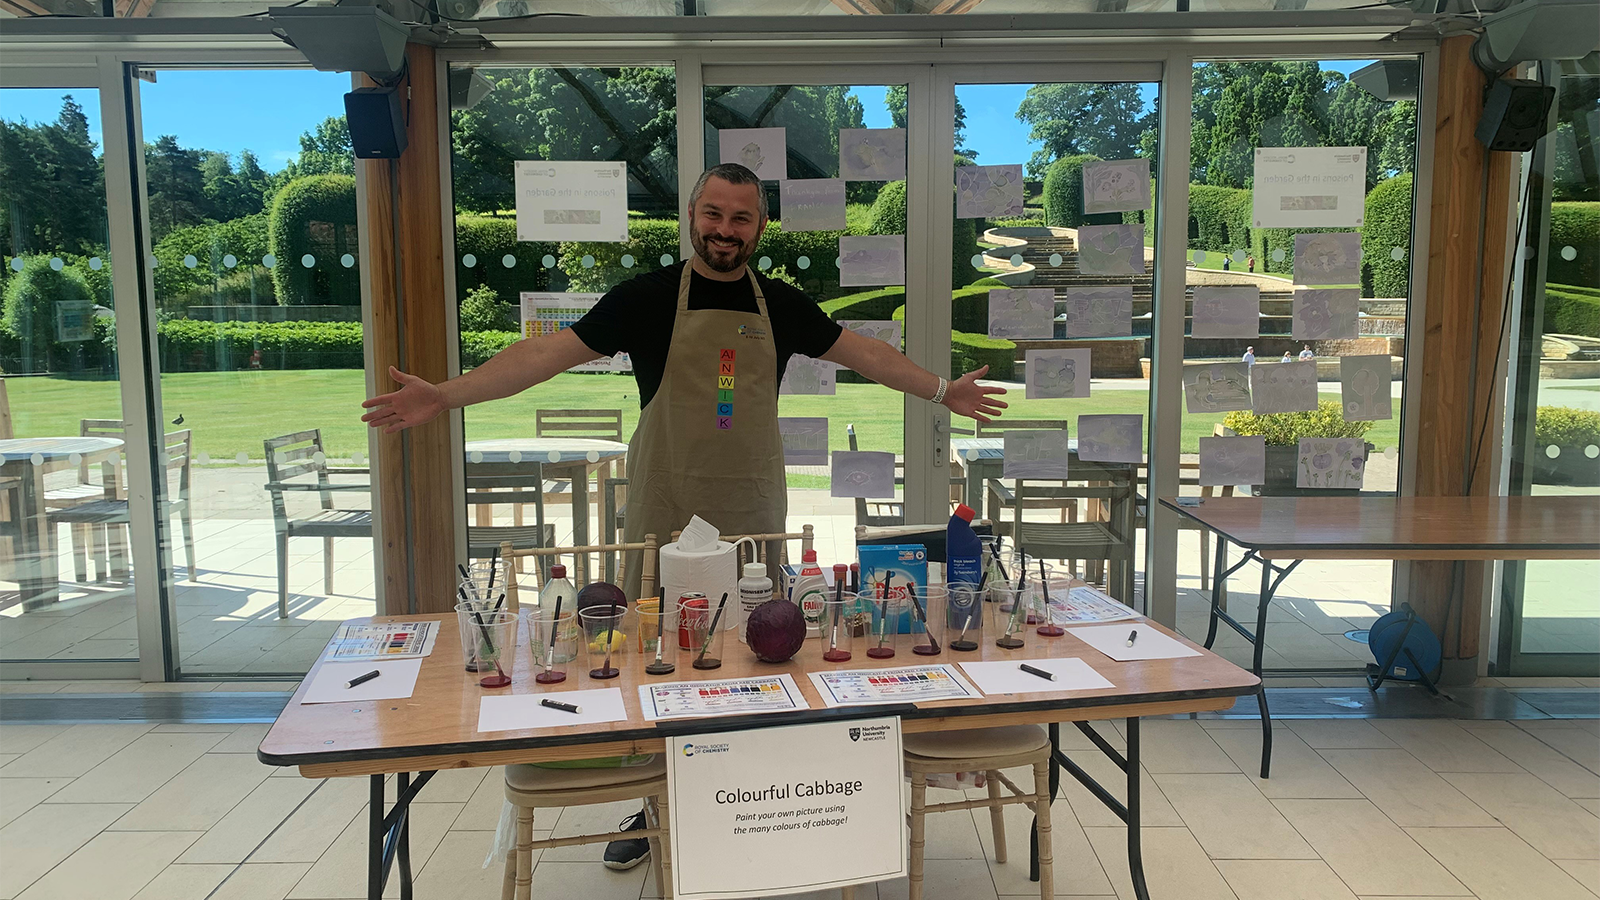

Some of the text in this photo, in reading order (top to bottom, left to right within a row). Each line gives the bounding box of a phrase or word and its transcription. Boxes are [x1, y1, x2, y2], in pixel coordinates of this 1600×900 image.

[715, 779, 863, 804] Colourful Cabbage
[735, 804, 846, 822] Paint your own picture using
[733, 815, 848, 835] the many colours of cabbage!
